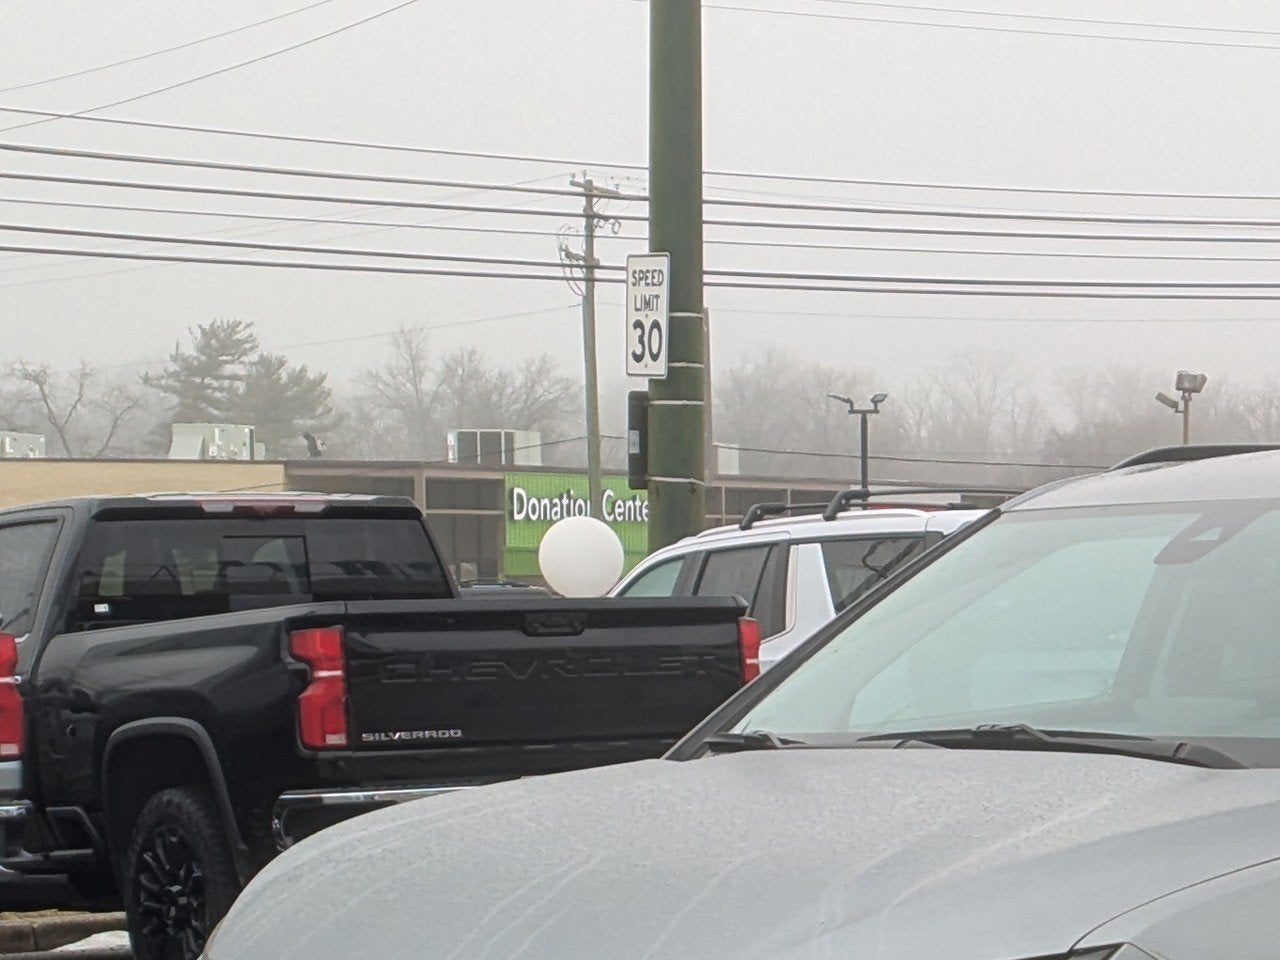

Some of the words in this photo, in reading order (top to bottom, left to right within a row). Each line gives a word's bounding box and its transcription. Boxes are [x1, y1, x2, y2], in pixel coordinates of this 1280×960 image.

[631, 268, 664, 287] SPEED
[634, 294, 660, 312] LIMIT
[631, 319, 663, 363] 30
[602, 489, 648, 521] Cente
[361, 729, 462, 741] SILVERADO
